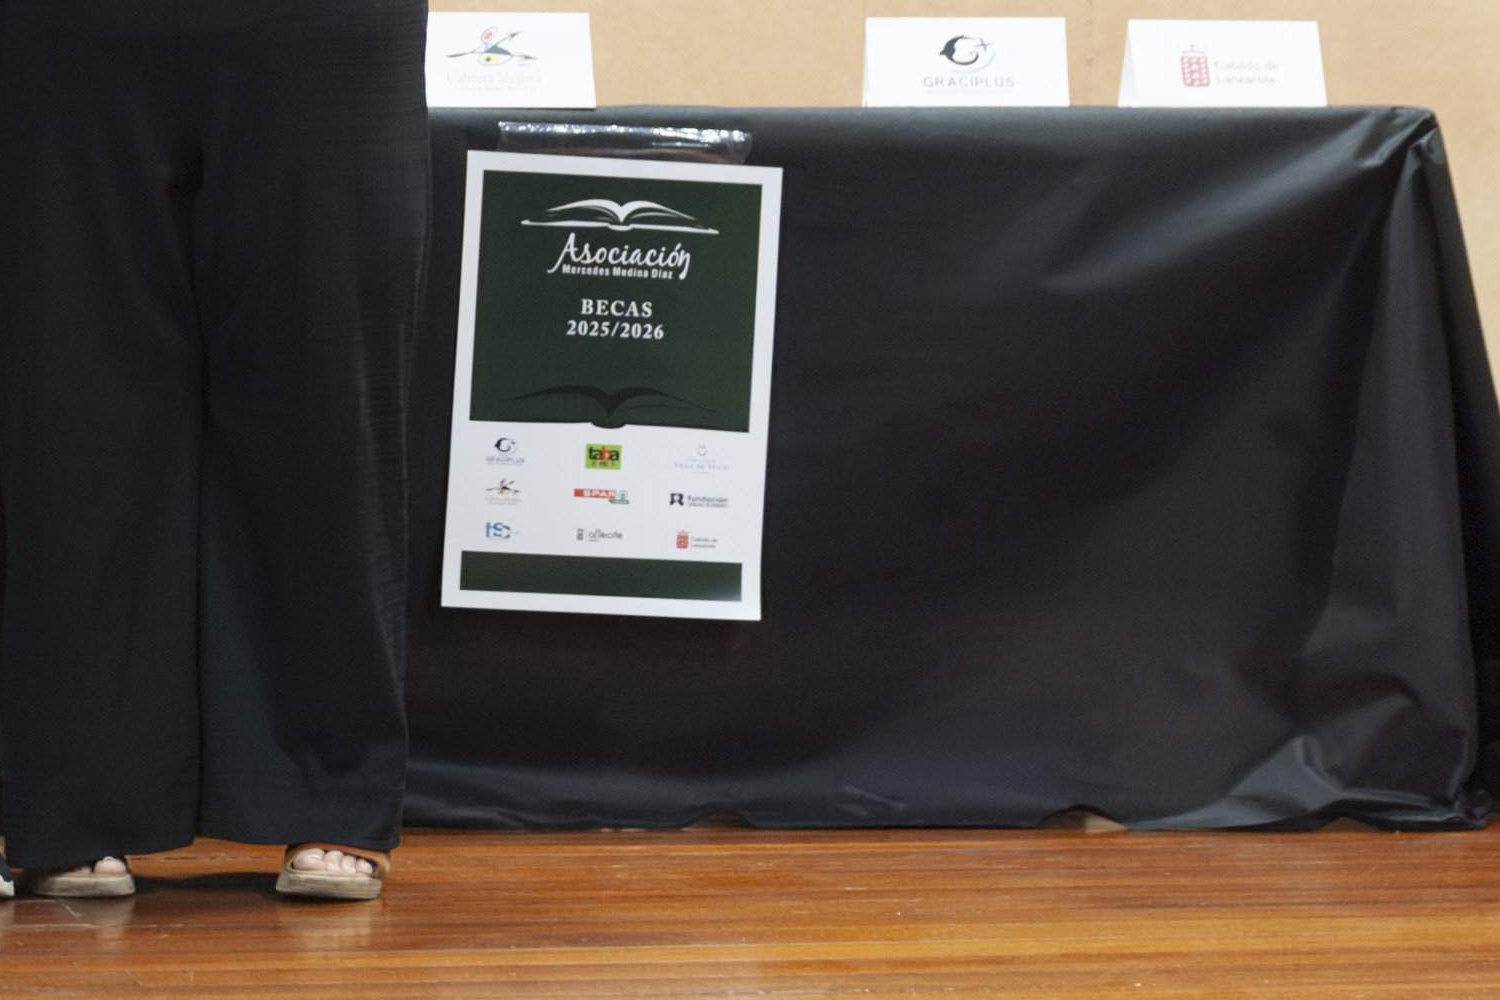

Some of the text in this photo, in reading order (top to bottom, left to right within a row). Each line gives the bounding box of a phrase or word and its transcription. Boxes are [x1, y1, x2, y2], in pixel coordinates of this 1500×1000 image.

[923, 76, 1015, 88] GRACIPLUS
[546, 232, 691, 280] Asociación
[562, 264, 610, 276] Mercedes
[612, 265, 649, 278] Medina
[581, 299, 653, 318] BECAS
[566, 320, 664, 340] 2025/2026
